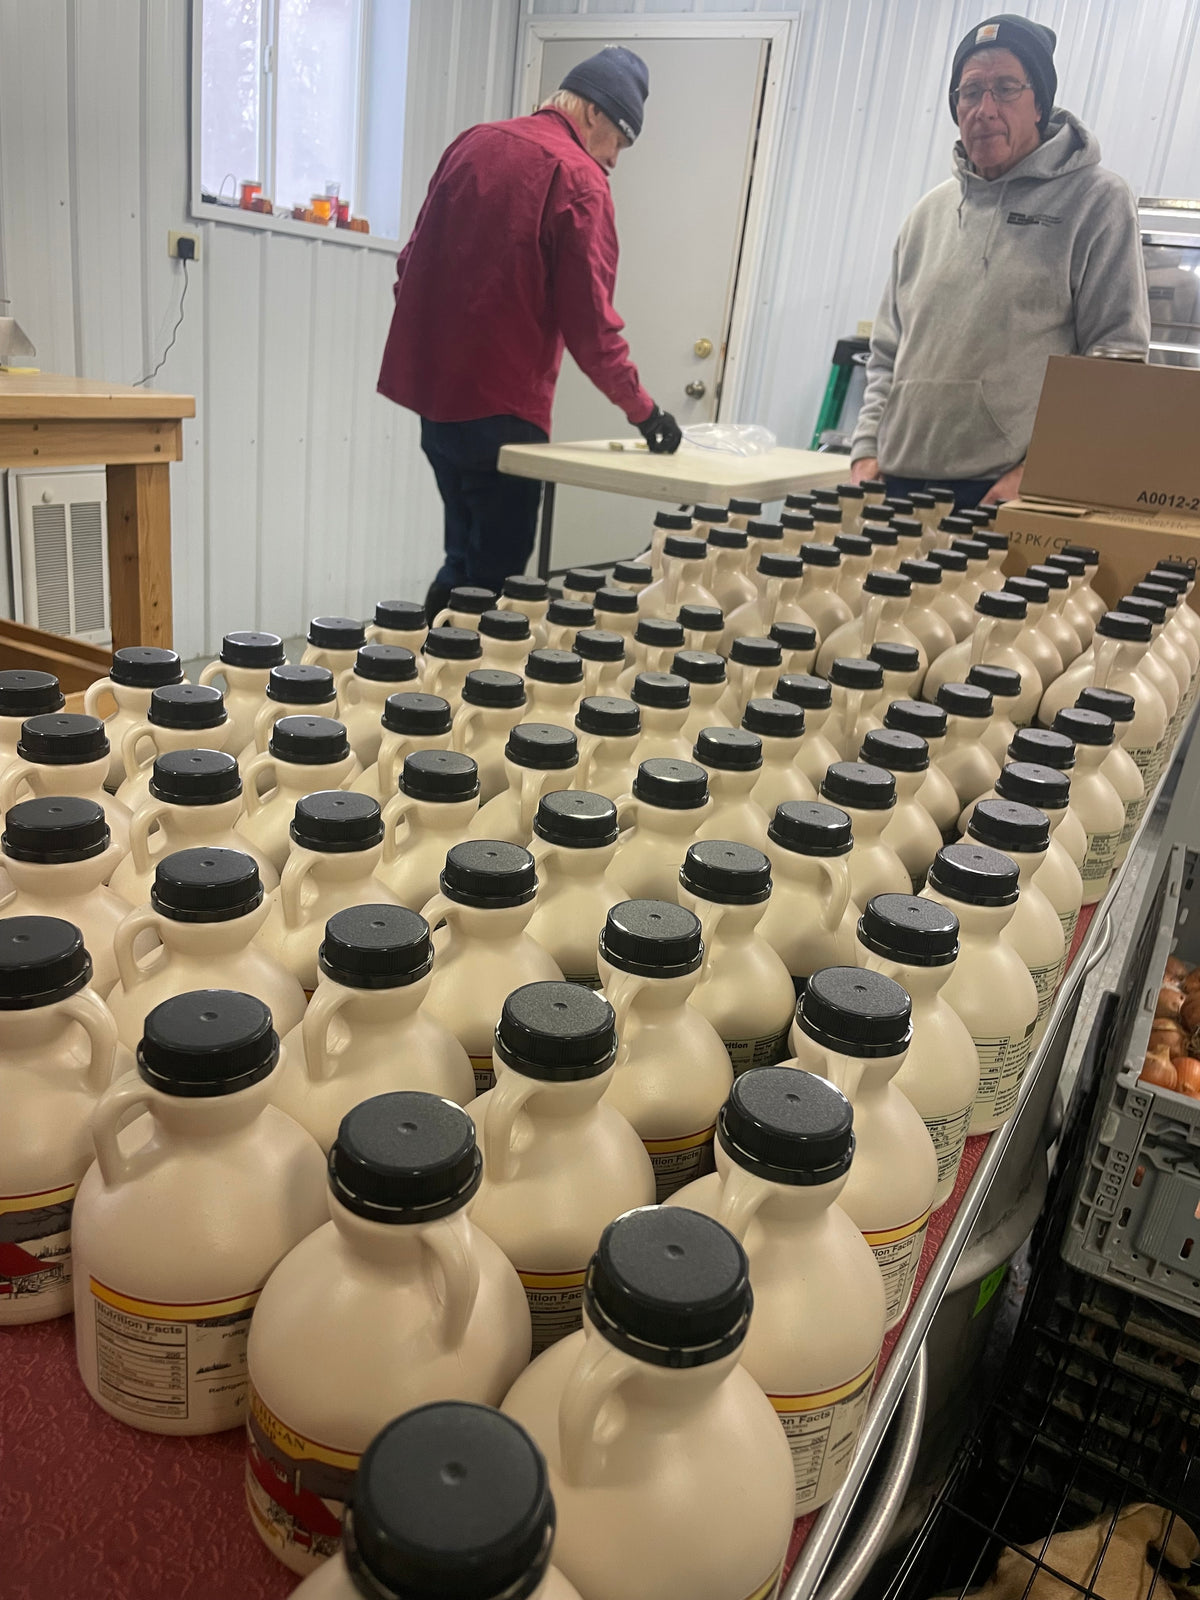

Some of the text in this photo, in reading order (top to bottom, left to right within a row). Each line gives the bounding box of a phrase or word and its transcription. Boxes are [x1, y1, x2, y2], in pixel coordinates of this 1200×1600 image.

[1136, 490, 1200, 511] A0012-2
[1009, 531, 1023, 544] 12
[1025, 533, 1042, 547] PK
[1043, 536, 1052, 548] /
[676, 1151, 699, 1163] Facts
[892, 1240, 913, 1253] Facts
[526, 1292, 582, 1302] rition Fac
[97, 1301, 143, 1329] Nutrition
[146, 1322, 183, 1335] Facts
[799, 1410, 831, 1424] Facts
